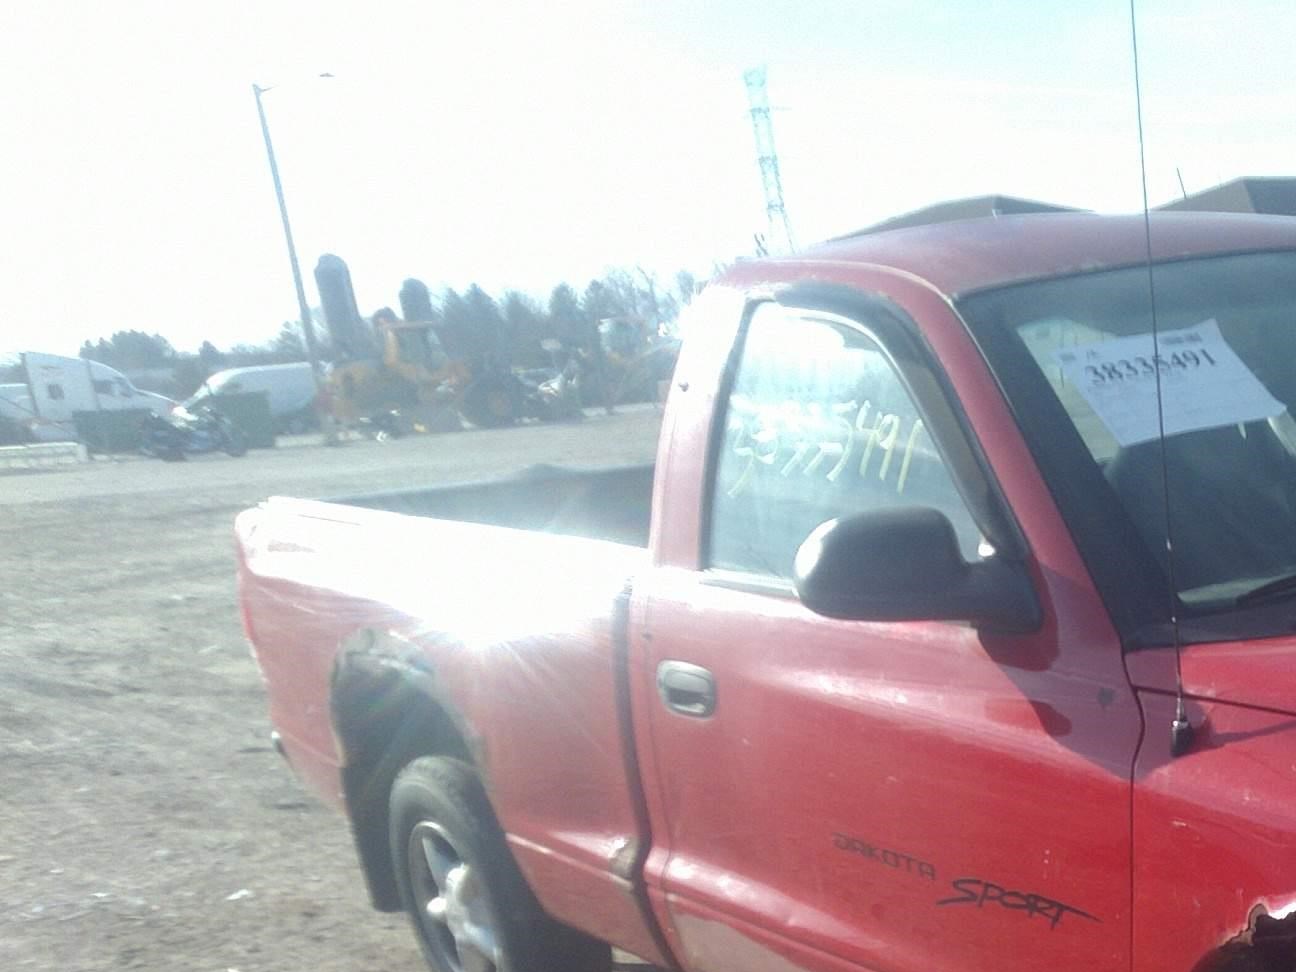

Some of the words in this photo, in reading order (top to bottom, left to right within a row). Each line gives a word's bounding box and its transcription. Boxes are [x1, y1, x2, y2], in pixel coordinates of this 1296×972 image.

[1084, 347, 1216, 386] 38335491
[832, 832, 937, 881] DAKOTA
[936, 877, 1104, 930] SPORT
